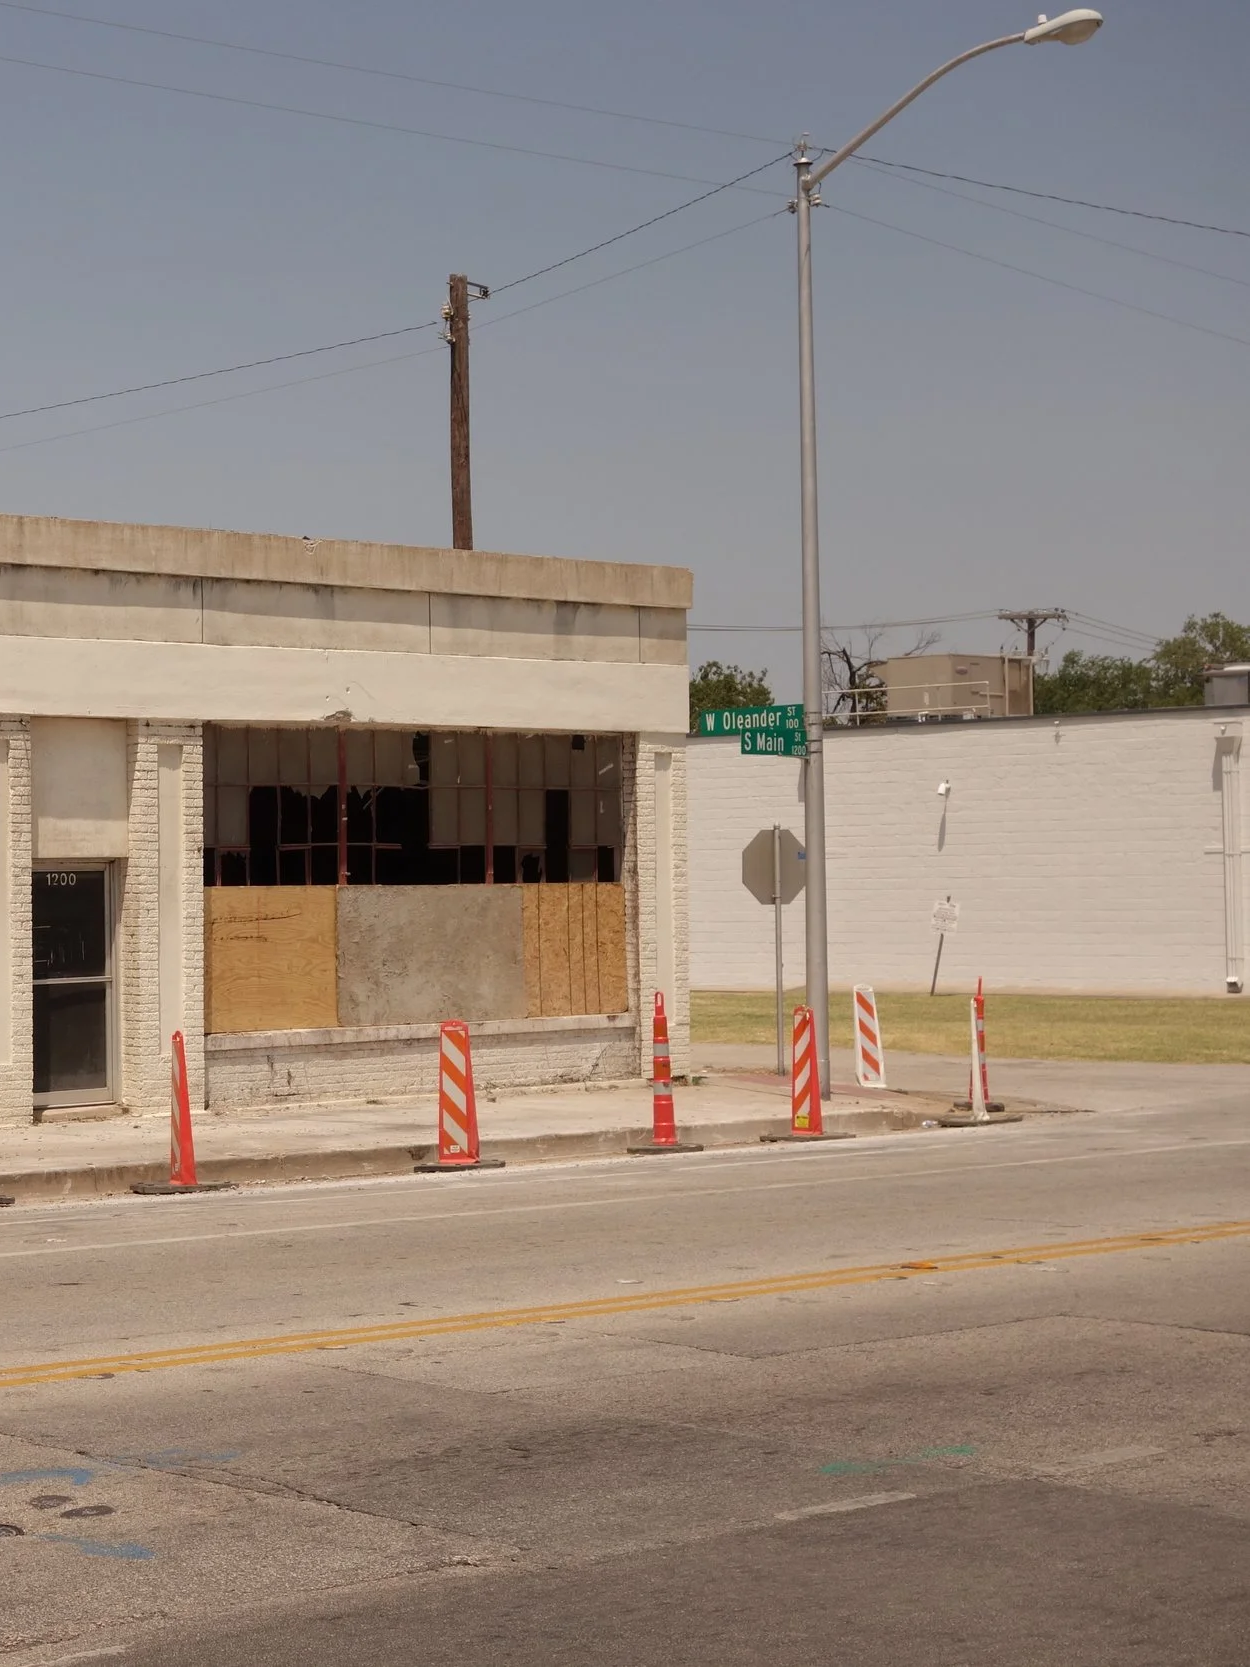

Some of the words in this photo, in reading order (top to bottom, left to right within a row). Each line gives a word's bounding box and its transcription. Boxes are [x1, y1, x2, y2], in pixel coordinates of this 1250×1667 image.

[705, 713, 715, 731] W
[723, 709, 782, 730] Oleander
[787, 706, 796, 716] ST
[786, 719, 799, 729] 100
[744, 732, 752, 751] S
[757, 732, 784, 752] Main
[794, 732, 801, 742] St
[791, 745, 807, 755] 1200
[46, 872, 77, 886] 1200
